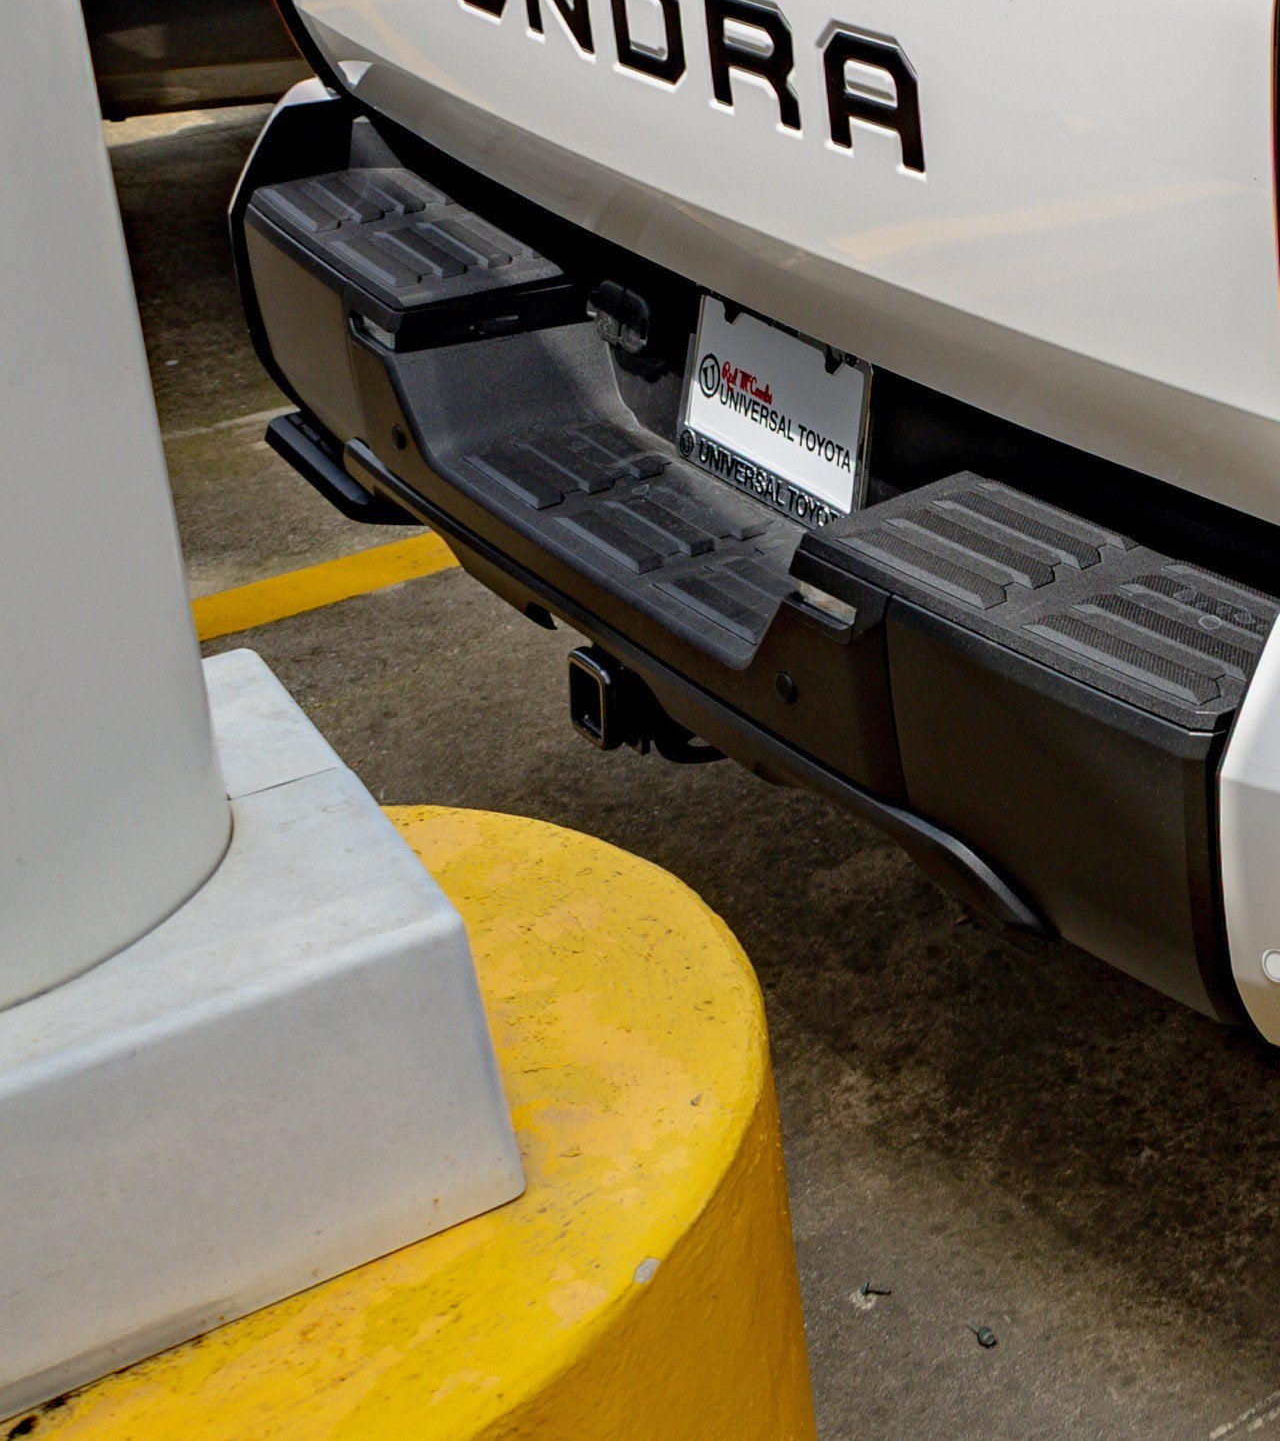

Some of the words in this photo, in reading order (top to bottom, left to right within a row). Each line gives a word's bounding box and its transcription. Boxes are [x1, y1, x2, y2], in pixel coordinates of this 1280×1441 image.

[720, 382, 795, 442] UNIVERSAL
[798, 424, 851, 473] TOYOTA
[698, 437, 785, 507] UNIVERSAL
[787, 485, 844, 527] TOYOT
